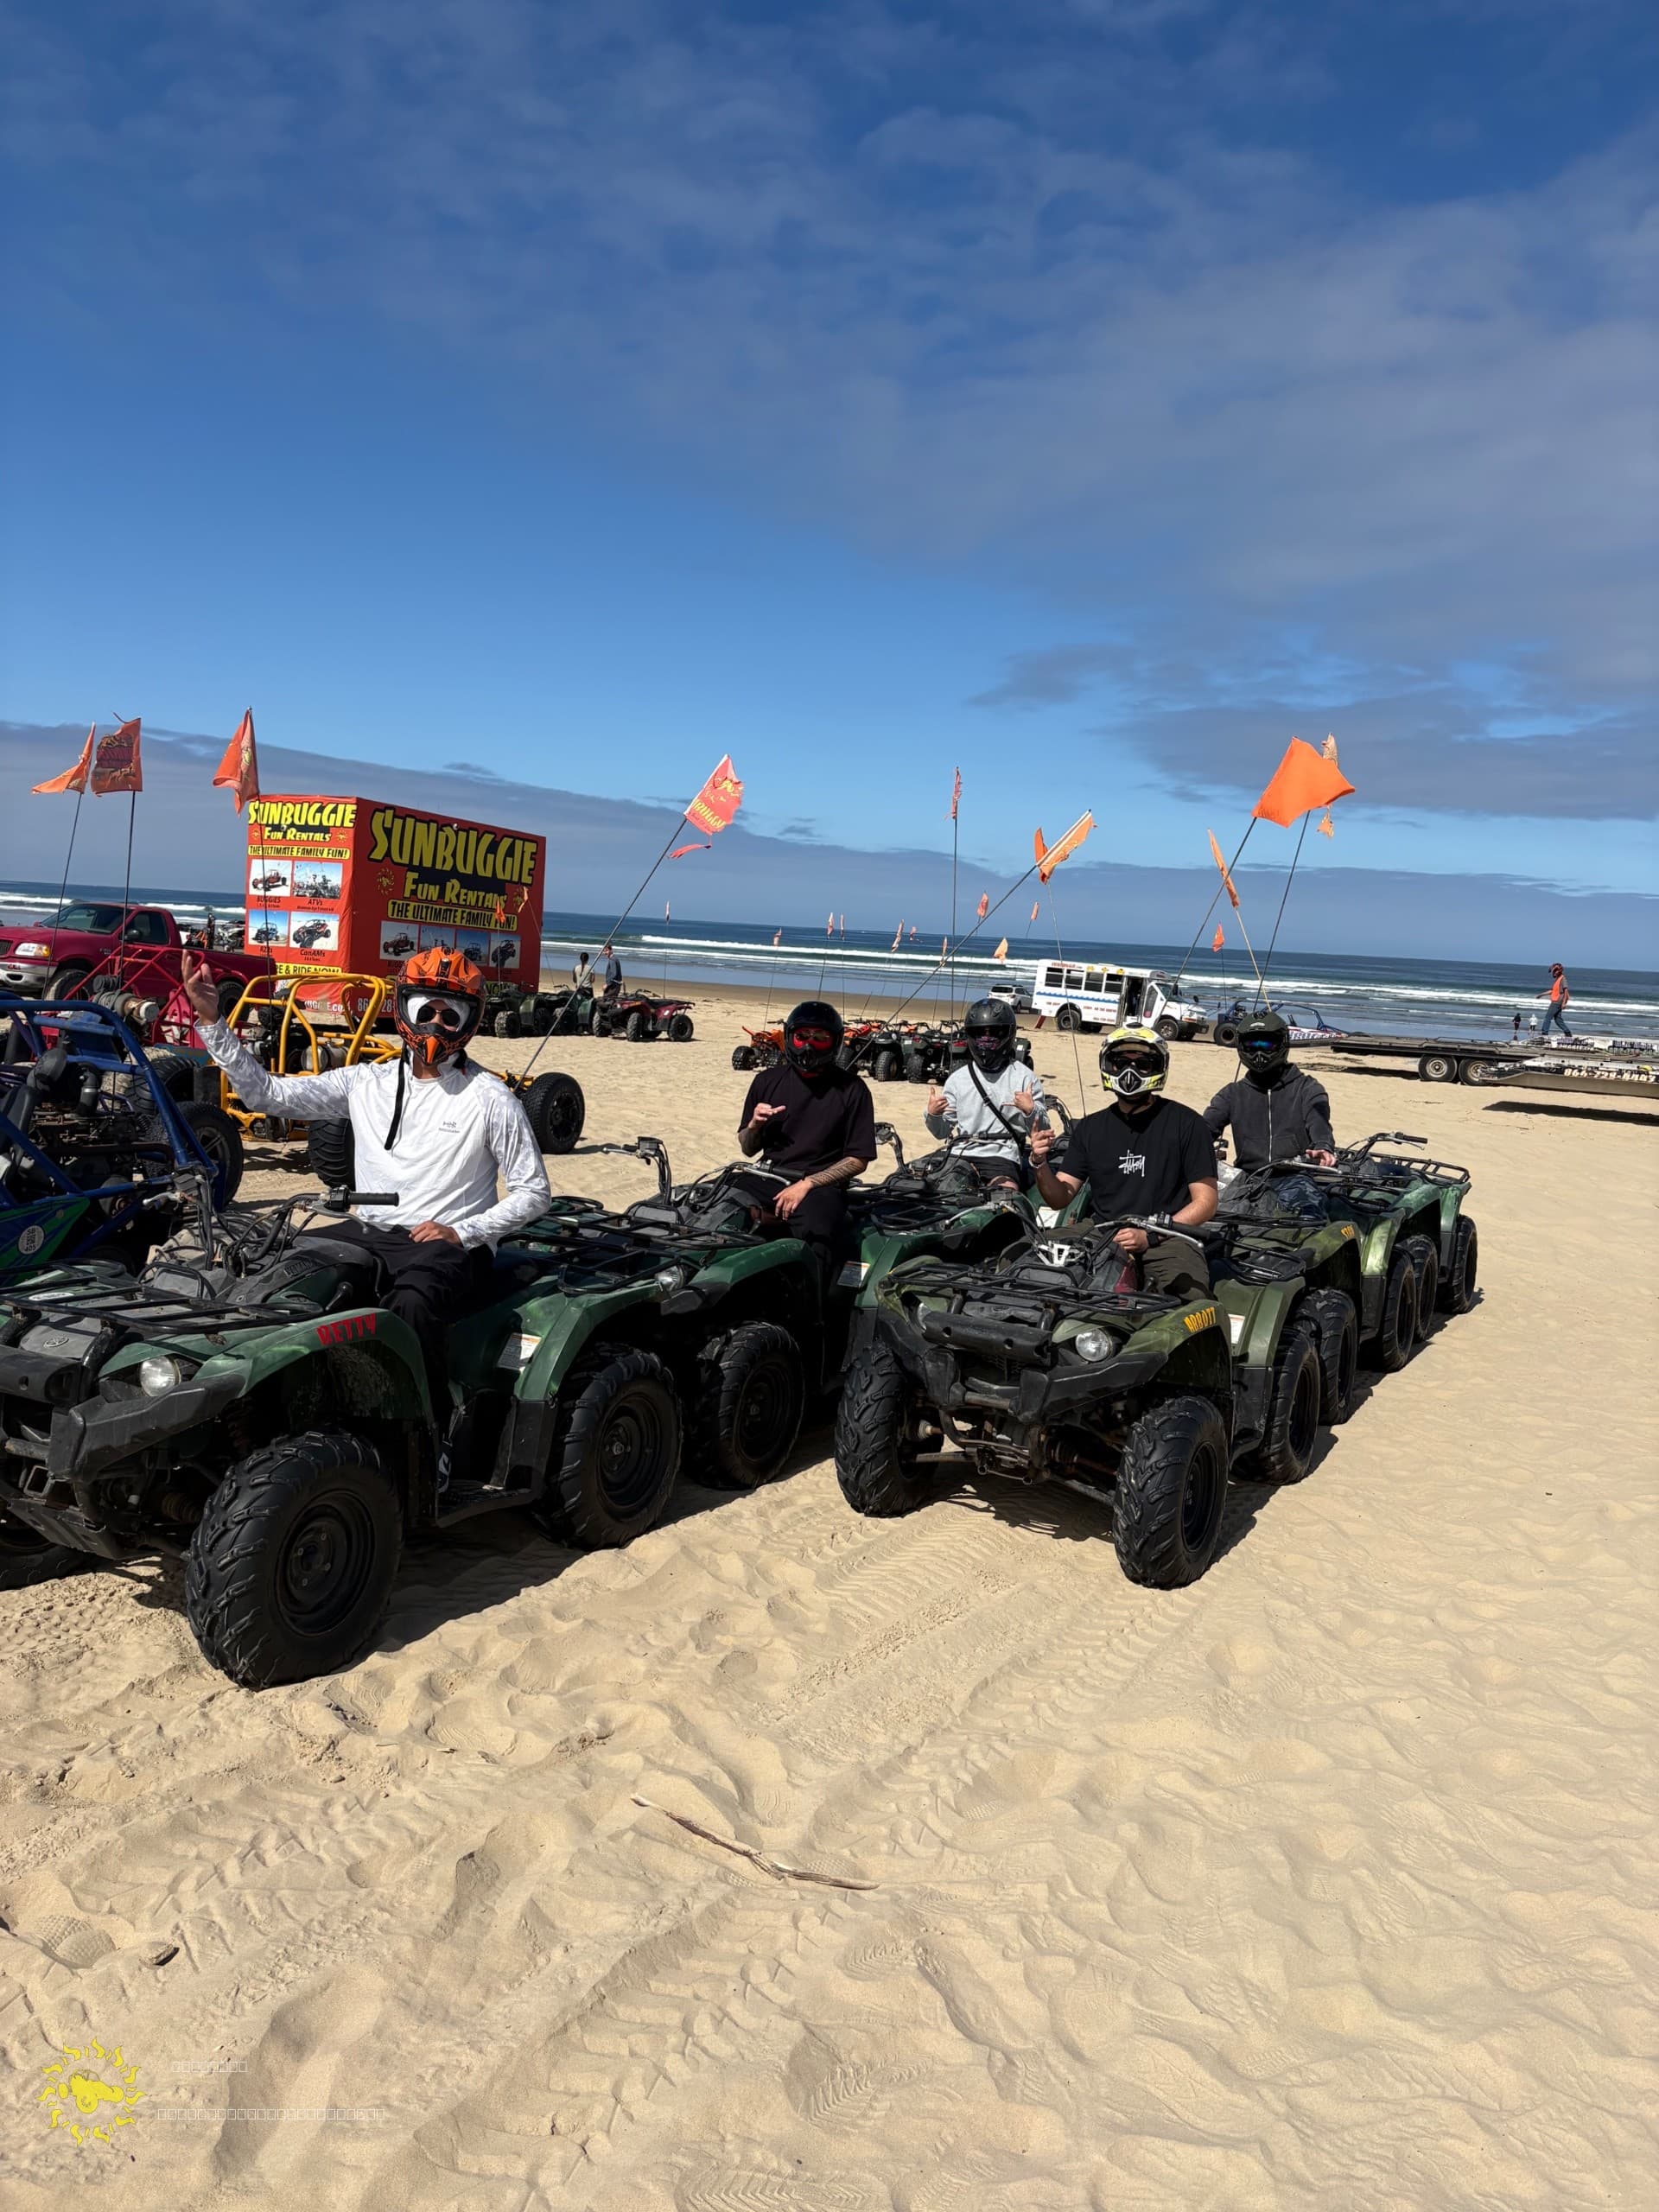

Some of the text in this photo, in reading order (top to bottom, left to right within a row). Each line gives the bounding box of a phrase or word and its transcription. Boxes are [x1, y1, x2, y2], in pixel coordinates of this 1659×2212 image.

[248, 800, 357, 827] SUNBUGGIE
[250, 846, 347, 858] THE ULTIMATE FAMILY FUN!
[369, 809, 537, 884] SUNBUGGIE
[391, 901, 410, 918] THE
[412, 904, 457, 924] ULTIMATE
[461, 908, 492, 927] FAMILY
